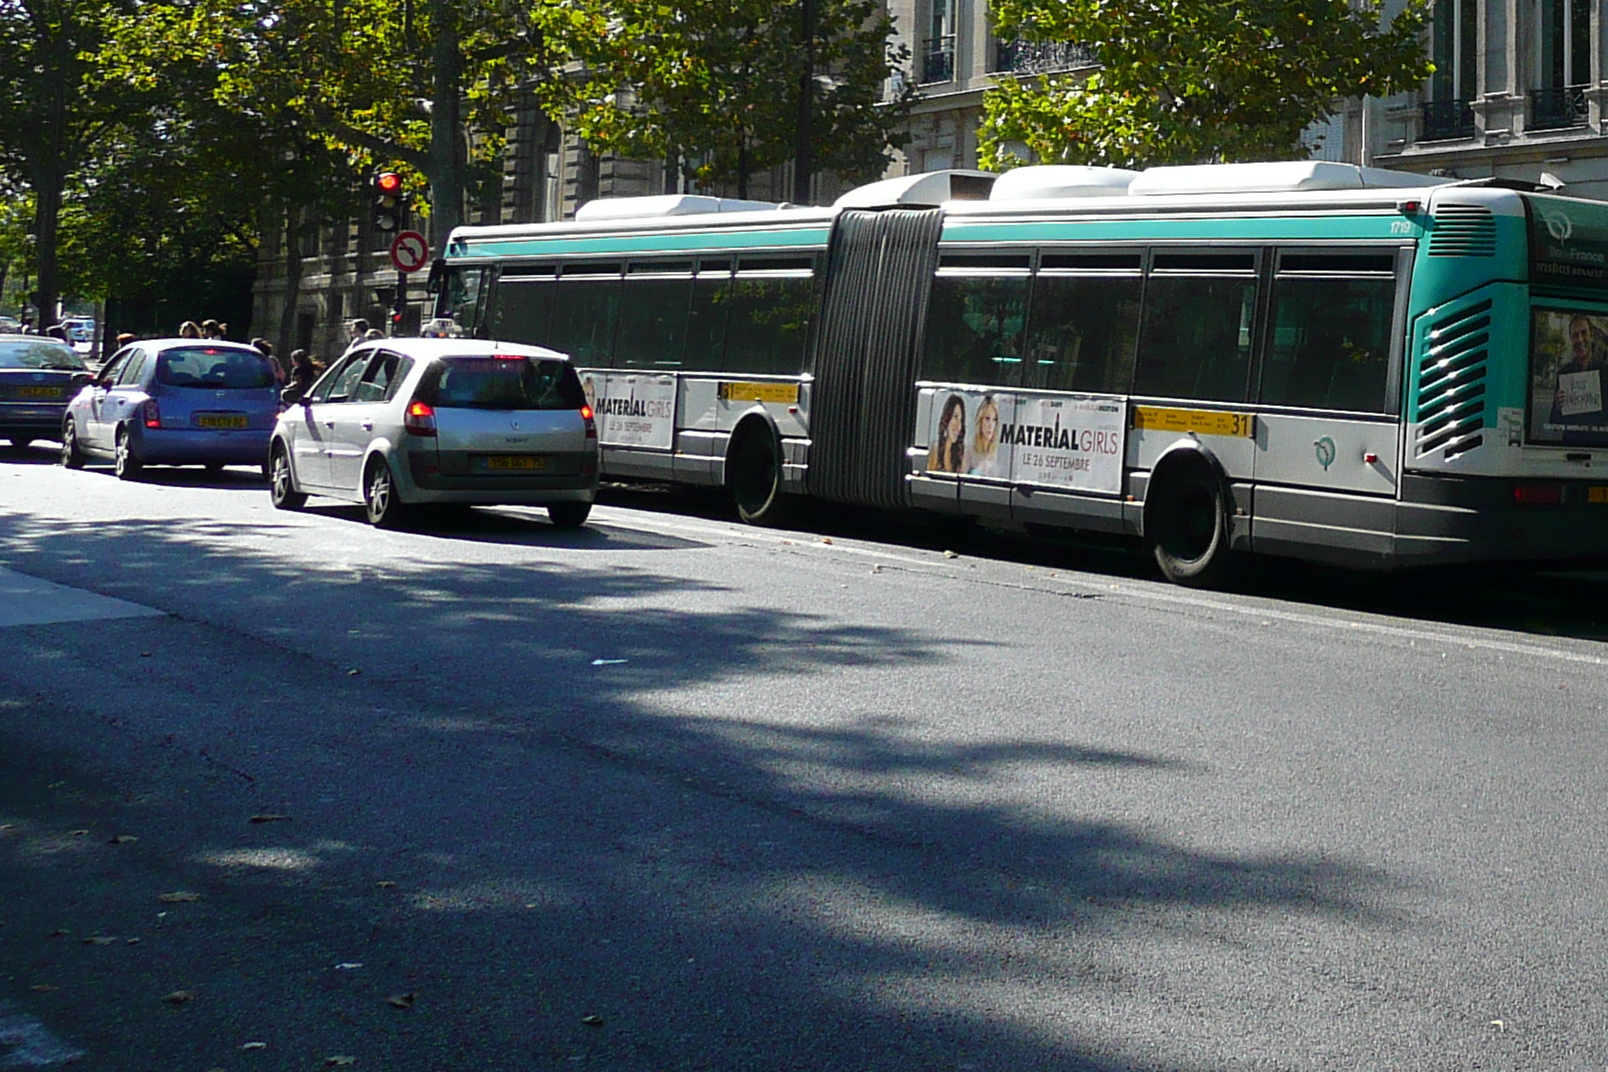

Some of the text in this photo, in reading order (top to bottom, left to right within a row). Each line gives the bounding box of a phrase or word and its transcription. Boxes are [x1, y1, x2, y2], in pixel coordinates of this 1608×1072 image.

[1390, 221, 1411, 234] 1719
[1570, 248, 1605, 263] France
[596, 388, 672, 418] MATERIAL GIRLS
[1000, 413, 1118, 455] MATERIAL GIRLS
[1231, 414, 1248, 436] 31
[1022, 453, 1091, 472] LE 26 SEPTEMBRE
